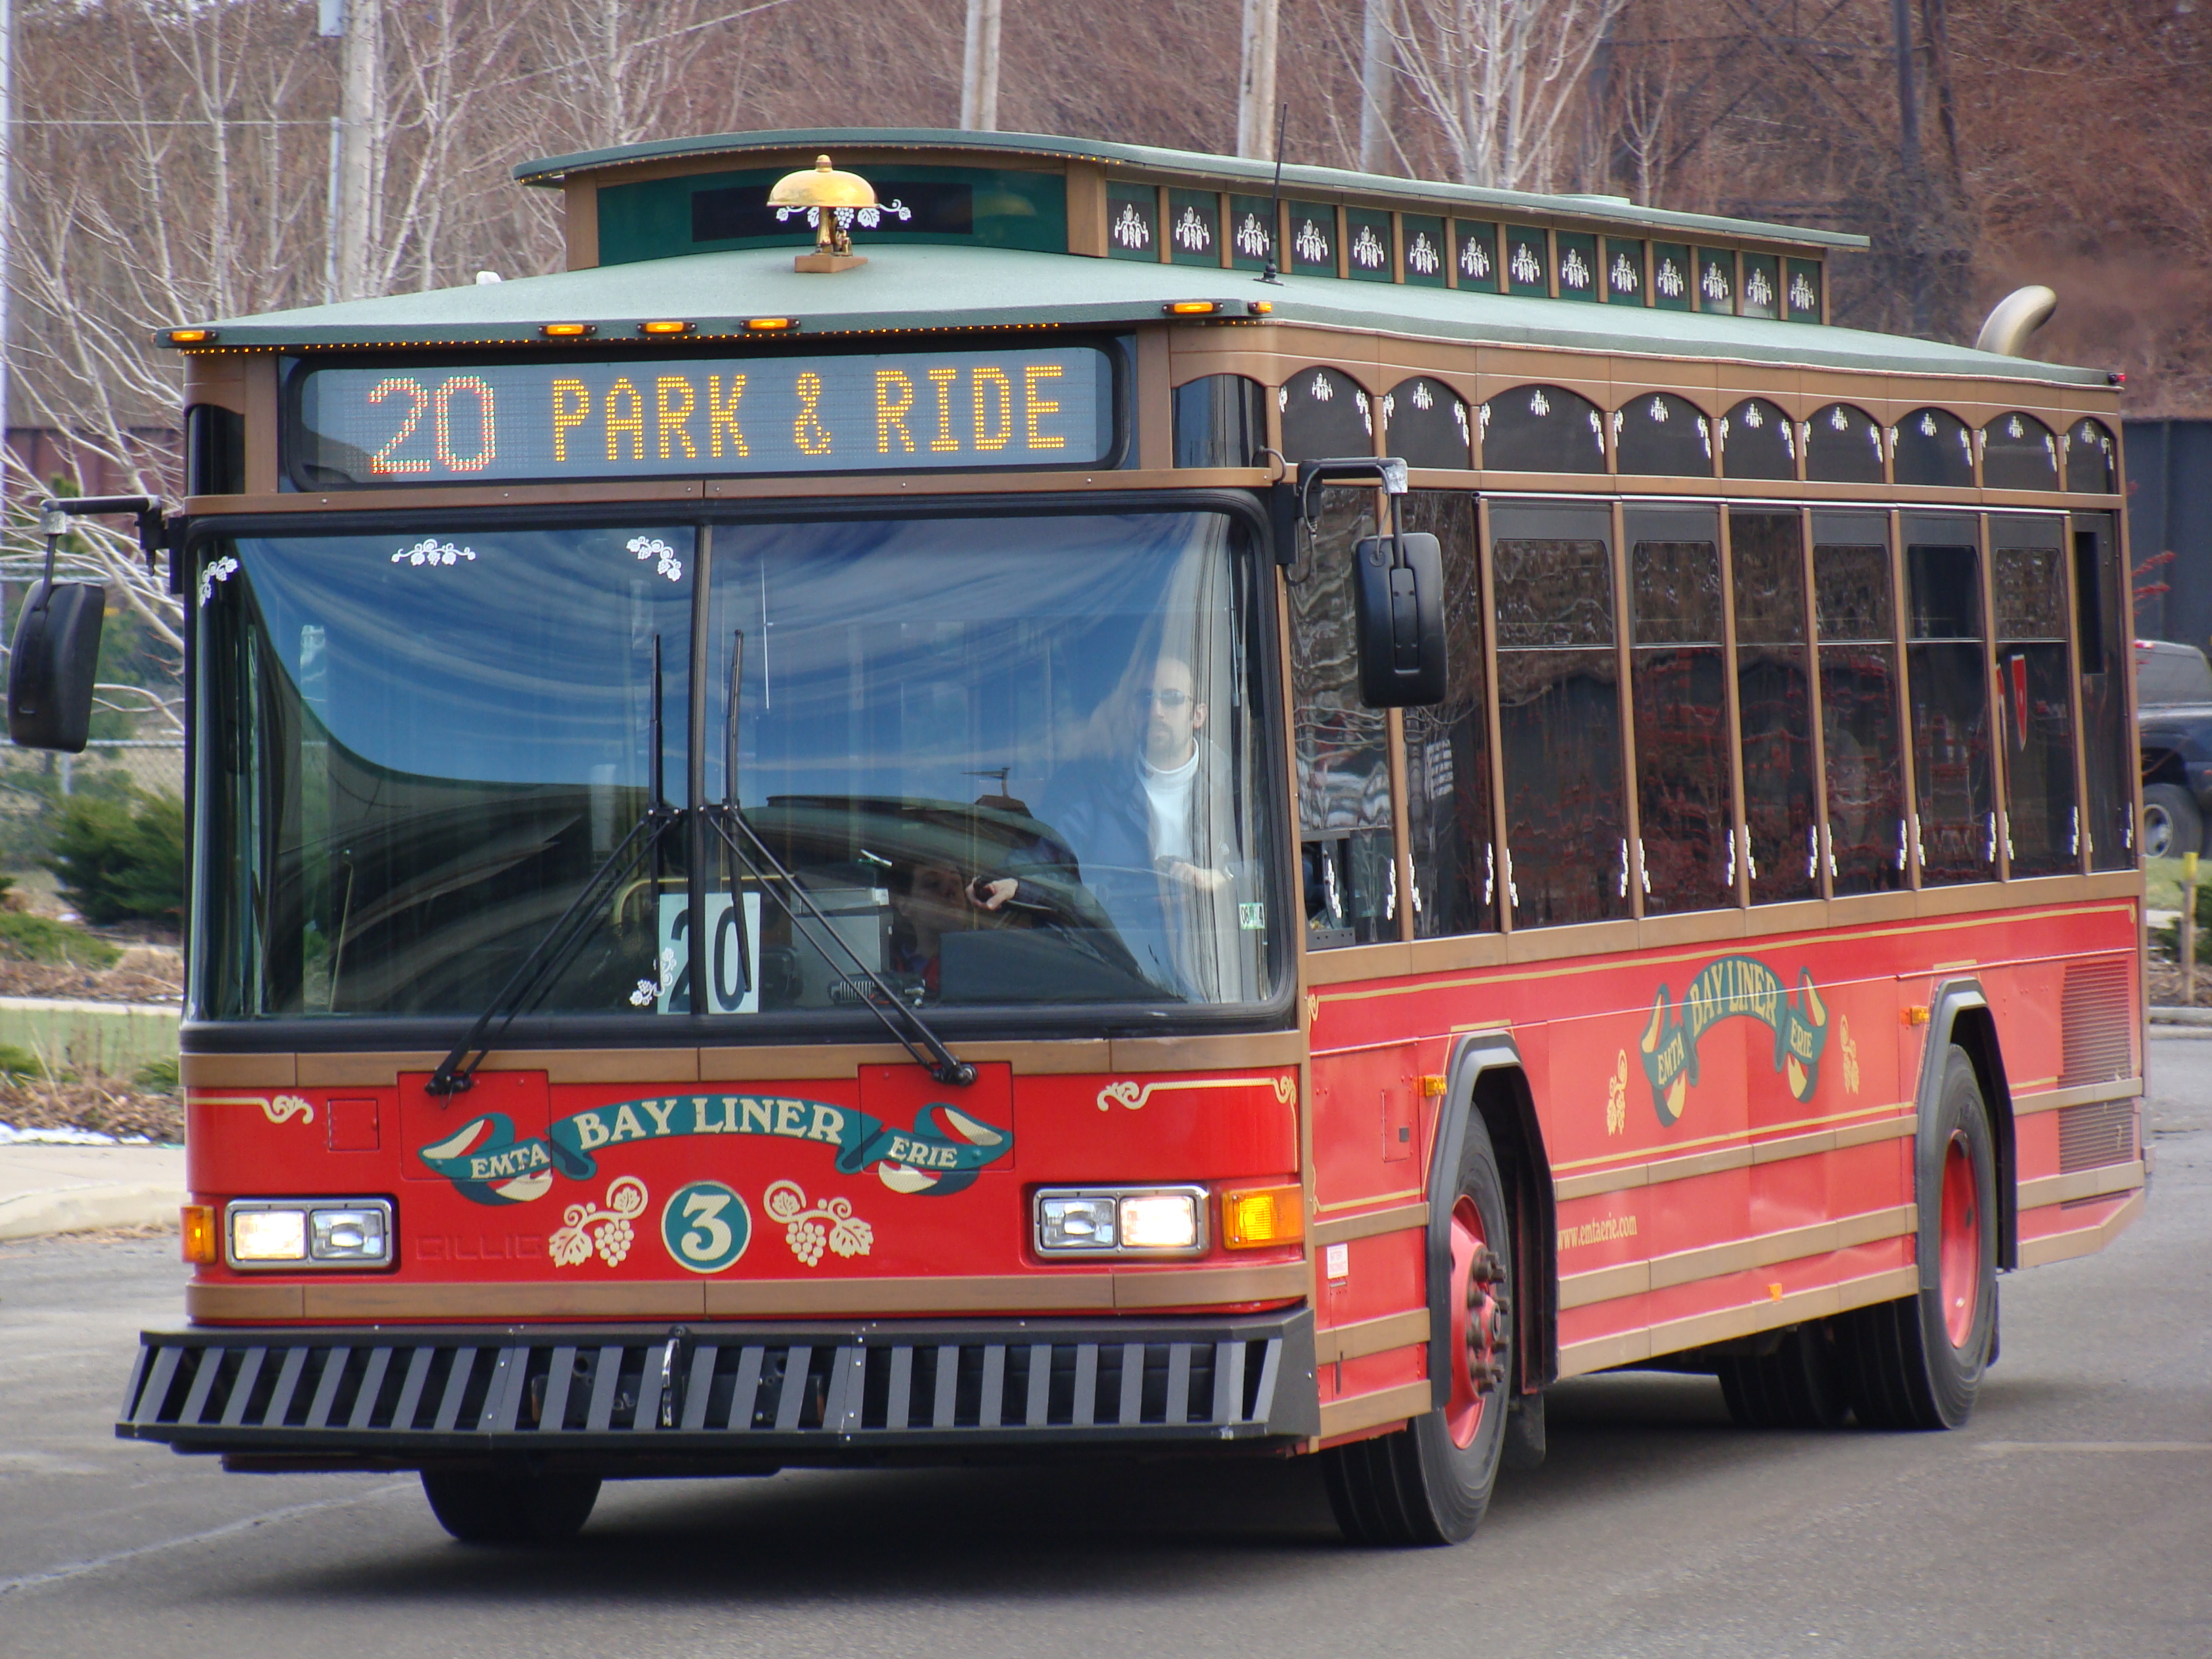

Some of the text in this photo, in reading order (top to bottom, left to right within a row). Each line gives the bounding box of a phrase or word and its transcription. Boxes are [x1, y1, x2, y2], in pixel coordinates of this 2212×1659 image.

[369, 365, 1066, 474] 20 PARK & RIDE
[1689, 960, 1778, 1038] BAY LINER
[1657, 1031, 1686, 1085] EMTA
[1790, 1016, 1814, 1059] ERIE
[573, 1097, 845, 1151] BAY LINER
[470, 1141, 550, 1181] EMTA
[890, 1135, 958, 1169] ERIE
[680, 1194, 733, 1263] 3
[1557, 1212, 1638, 1252] www.emtaerie.com
